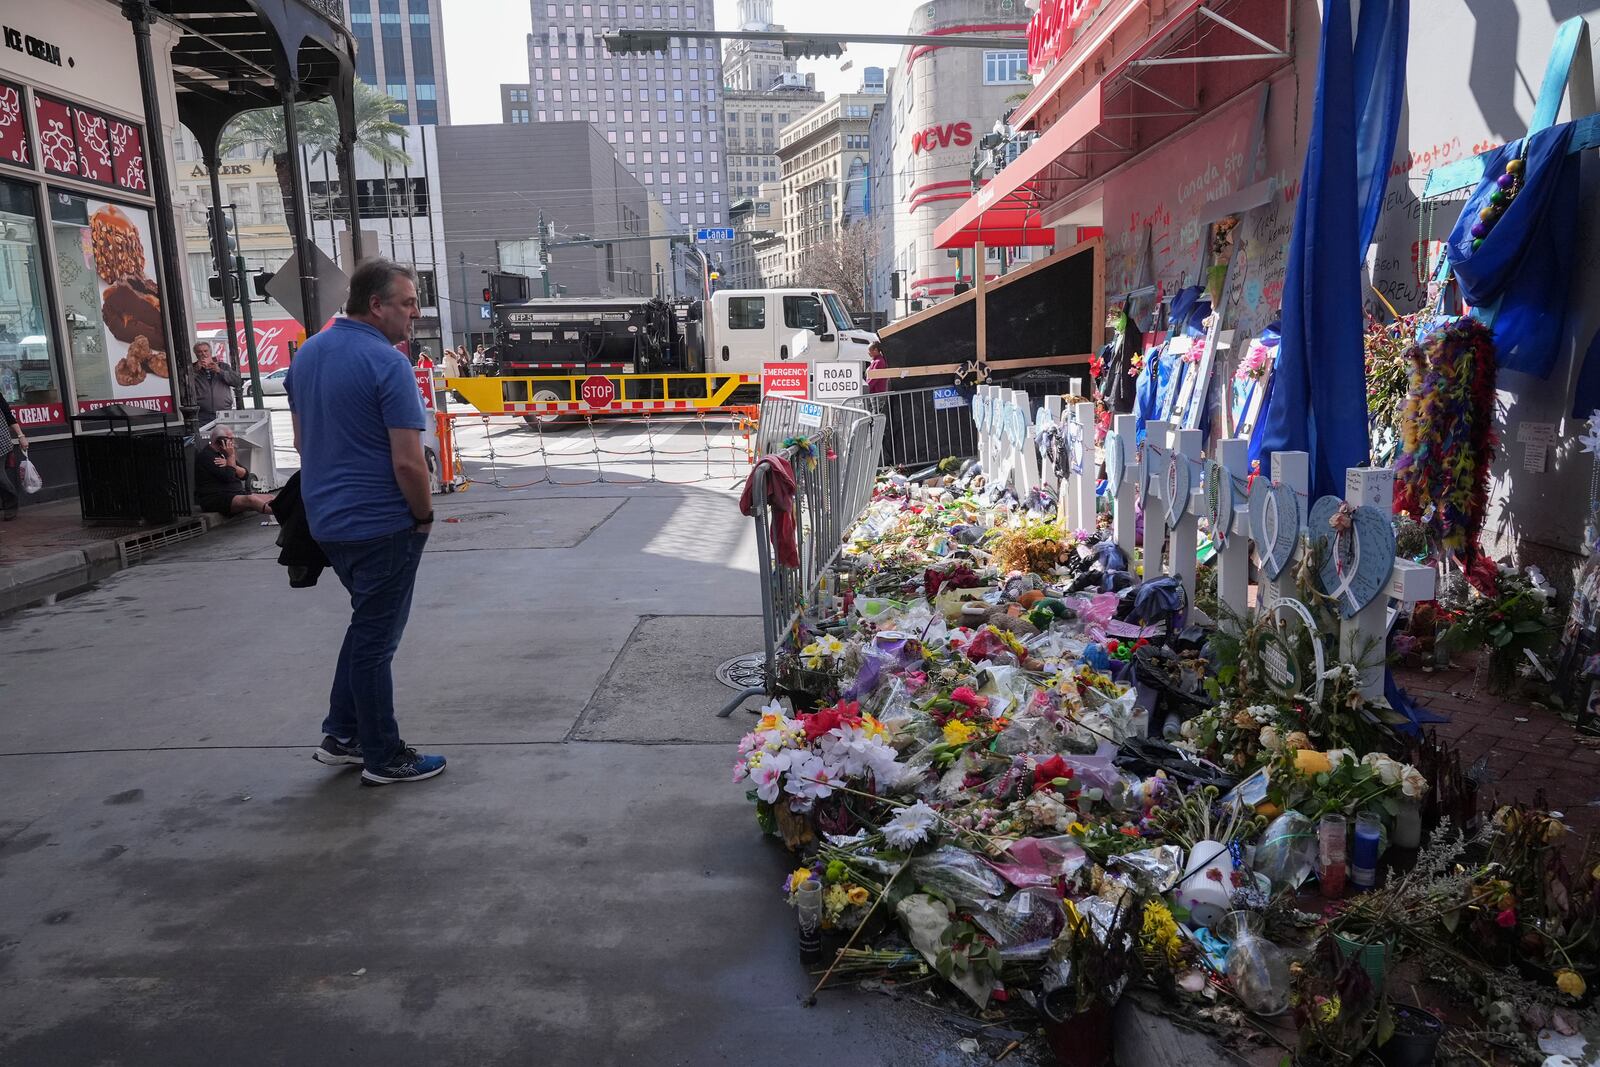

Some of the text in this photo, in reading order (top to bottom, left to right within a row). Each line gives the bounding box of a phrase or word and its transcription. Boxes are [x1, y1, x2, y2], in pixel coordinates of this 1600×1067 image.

[2, 25, 62, 67] ICE CREAM
[921, 122, 973, 152] CVS
[706, 229, 728, 239] Canal
[1378, 279, 1419, 303] DREW
[764, 368, 808, 376] EMERGENCY
[823, 368, 853, 379] ROAD
[954, 359, 993, 380] EMS
[771, 379, 801, 387] ACCESS
[818, 381, 859, 392] CLOSED
[583, 386, 612, 398] STOP
[18, 406, 51, 424] CREAM
